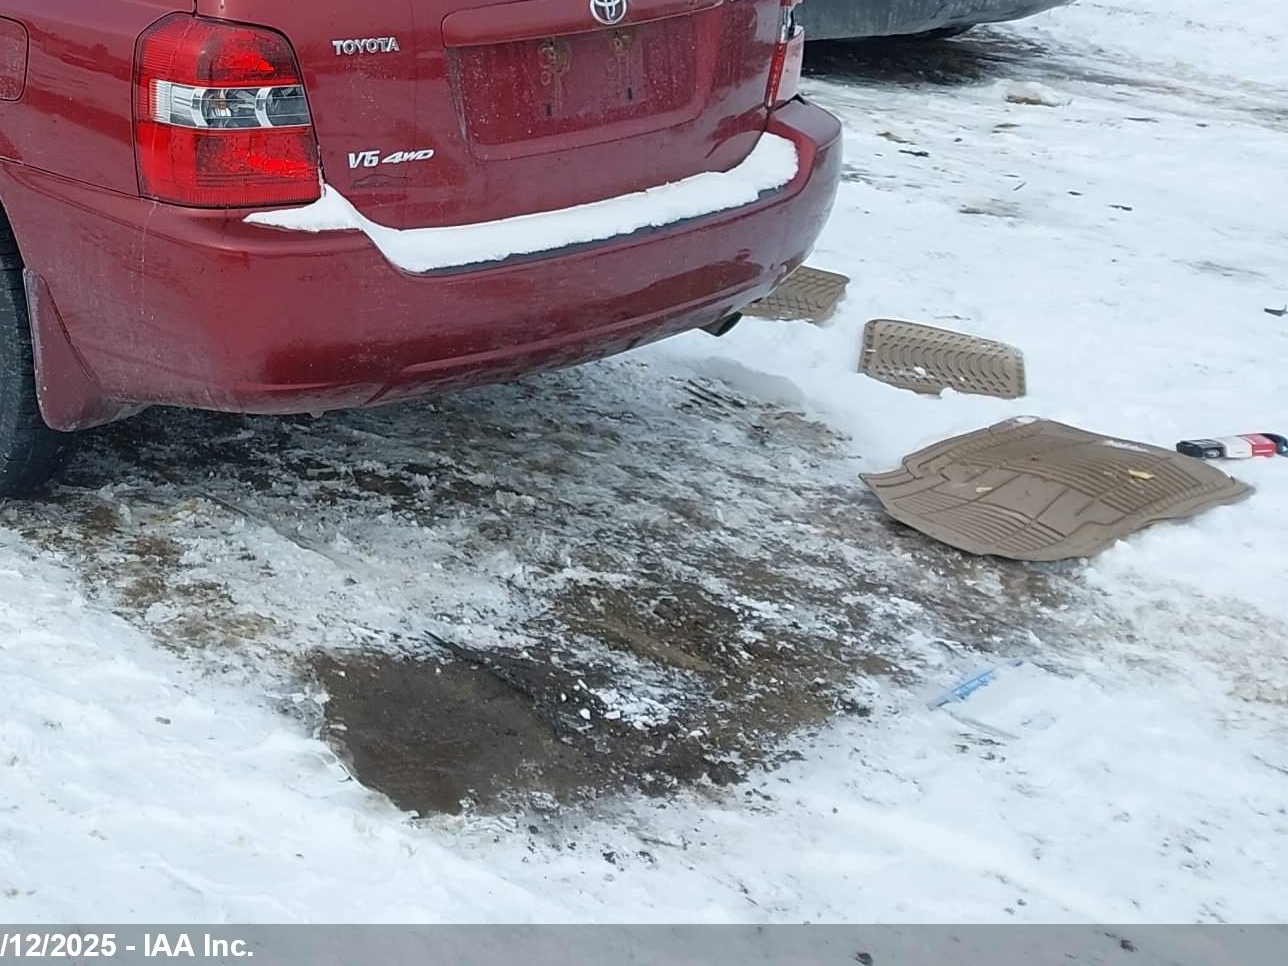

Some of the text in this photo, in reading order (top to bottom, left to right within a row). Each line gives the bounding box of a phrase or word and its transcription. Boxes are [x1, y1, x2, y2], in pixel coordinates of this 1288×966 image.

[332, 37, 400, 55] TOYOTA
[348, 149, 434, 168] V6 4WD
